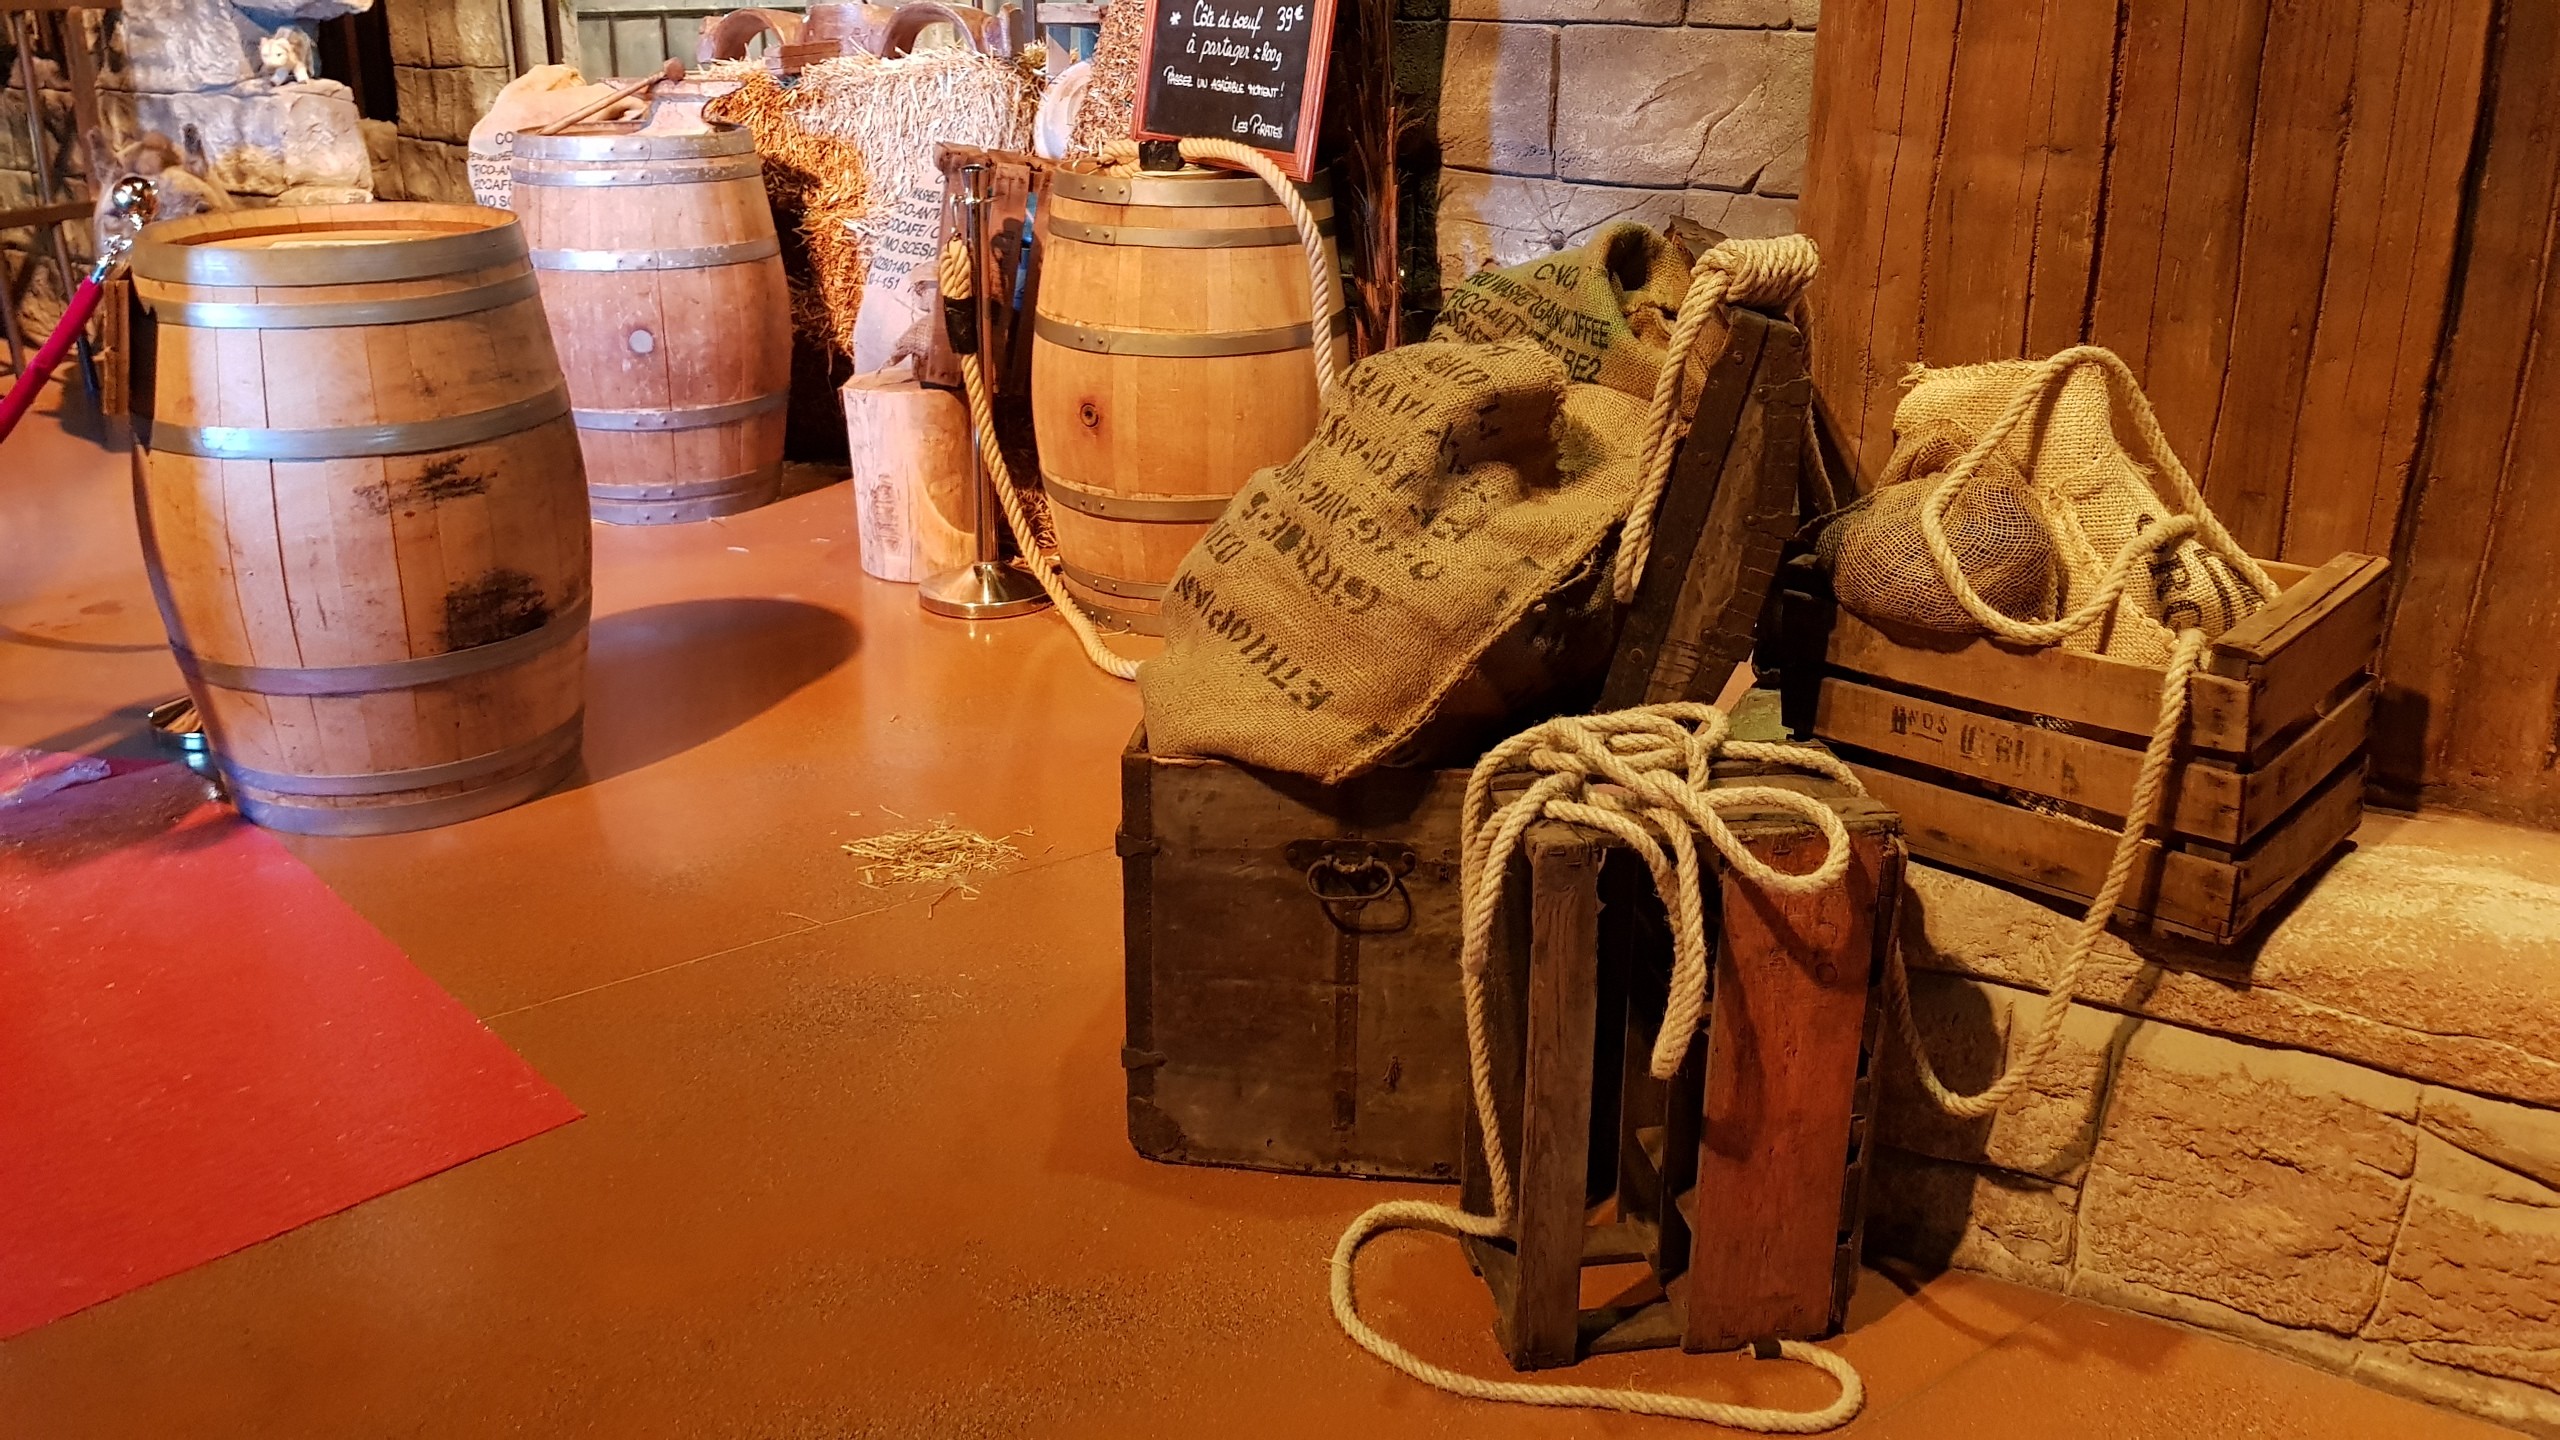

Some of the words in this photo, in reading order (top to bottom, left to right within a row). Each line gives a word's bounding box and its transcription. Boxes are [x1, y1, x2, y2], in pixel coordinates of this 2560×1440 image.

[1193, 0, 1215, 26] Côte
[1218, 9, 1231, 28] de
[1277, 4, 1304, 31] 39€
[1186, 32, 1196, 53] à
[1199, 37, 1249, 65] partager
[1197, 77, 1208, 88] UN
